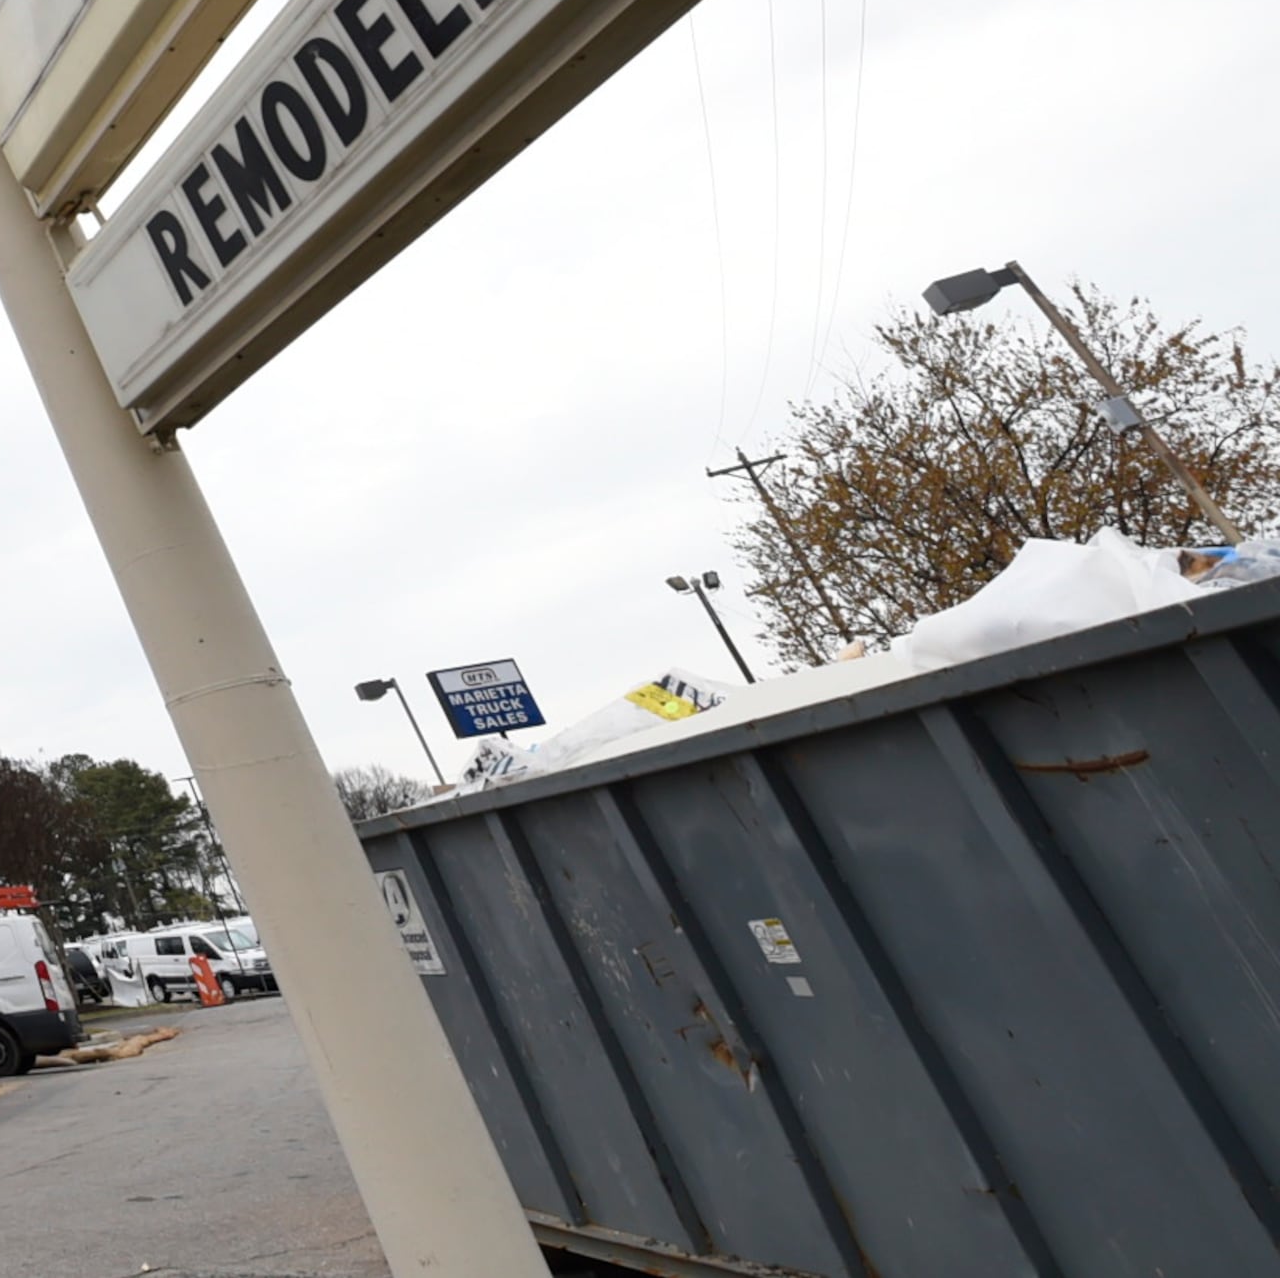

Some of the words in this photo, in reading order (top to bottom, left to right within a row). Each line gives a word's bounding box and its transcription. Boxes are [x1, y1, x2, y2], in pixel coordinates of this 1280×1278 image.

[447, 683, 528, 706] MARIETTA
[465, 697, 525, 717] TRUCK
[473, 711, 529, 730] SALES
